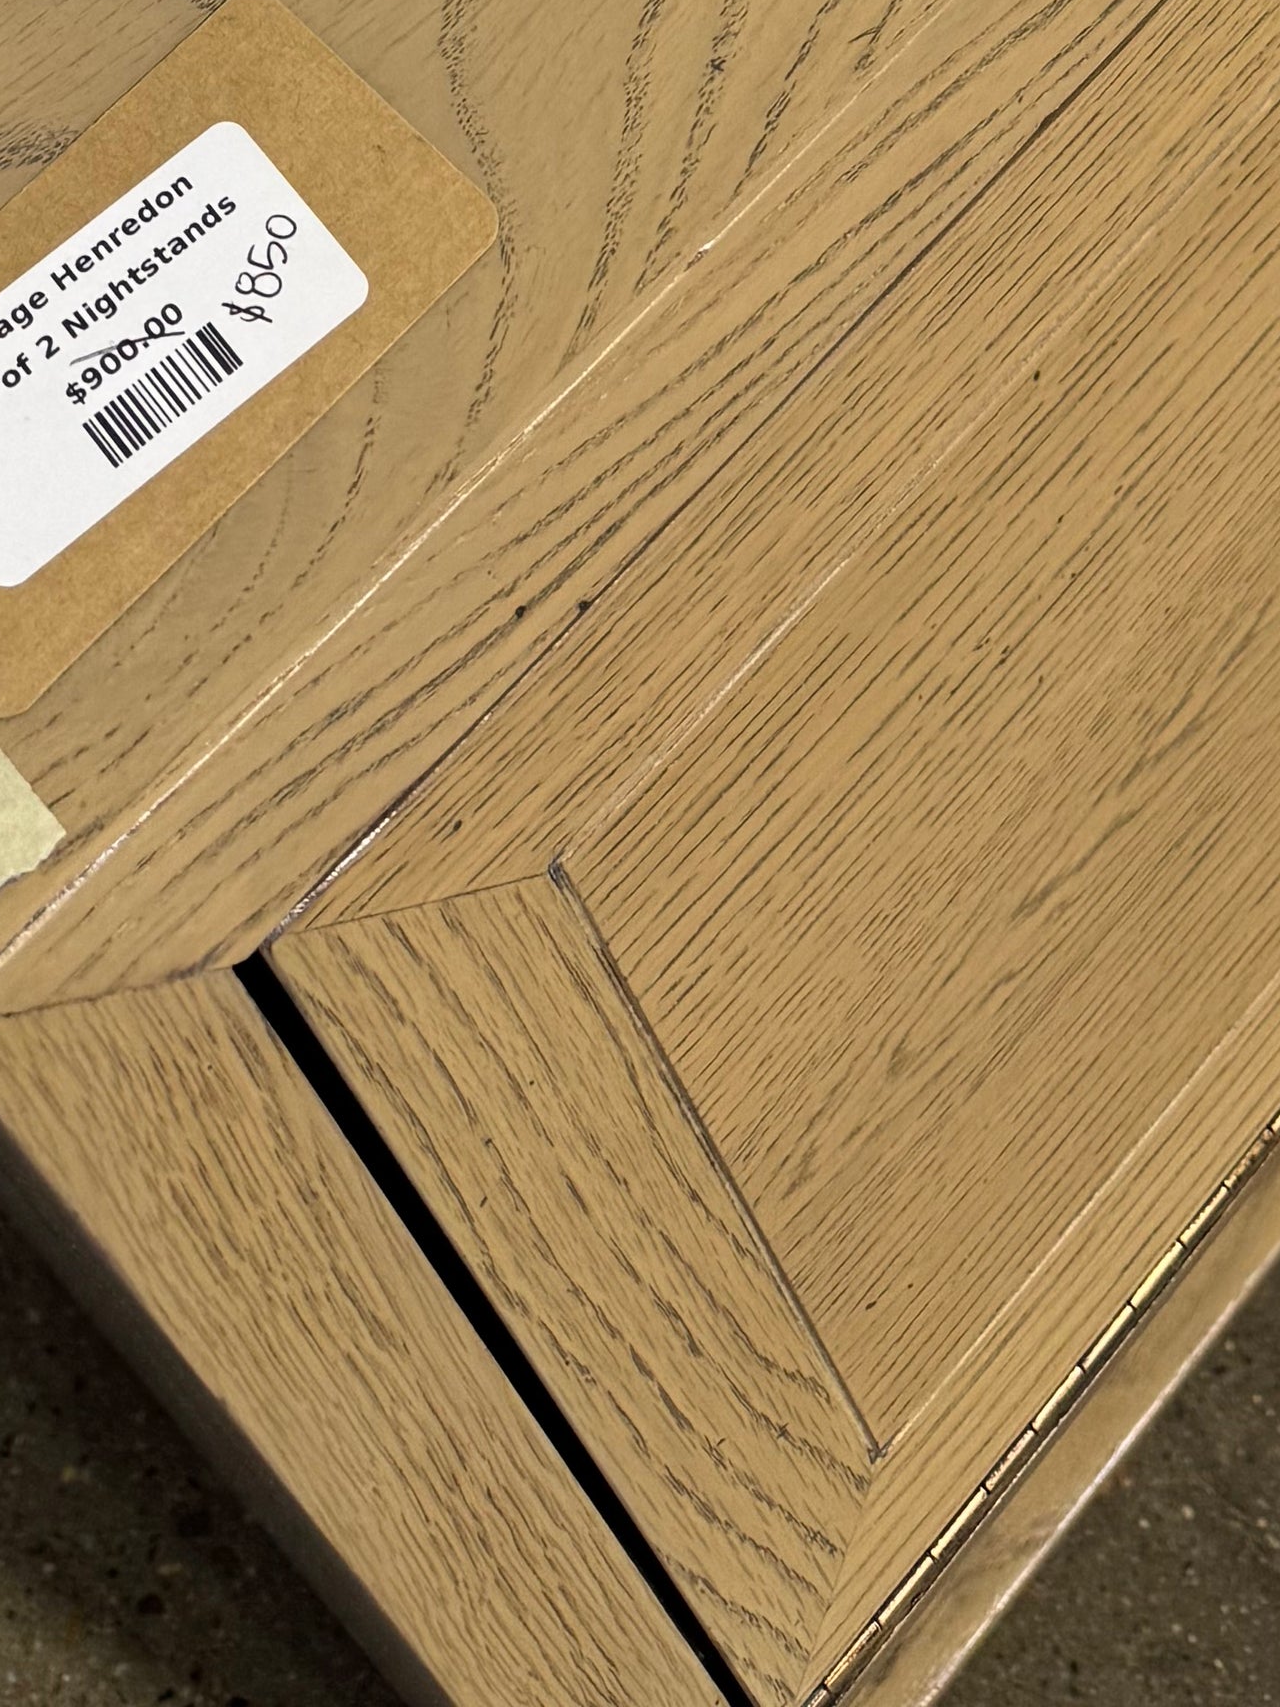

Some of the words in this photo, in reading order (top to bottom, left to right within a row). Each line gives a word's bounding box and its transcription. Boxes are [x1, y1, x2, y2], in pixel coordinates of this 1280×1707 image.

[50, 173, 194, 291] Henredon
[221, 213, 298, 324] $850
[1, 352, 34, 389] of
[35, 335, 61, 360] 2
[61, 193, 237, 339] Nightstands
[65, 302, 185, 406] $900.00
